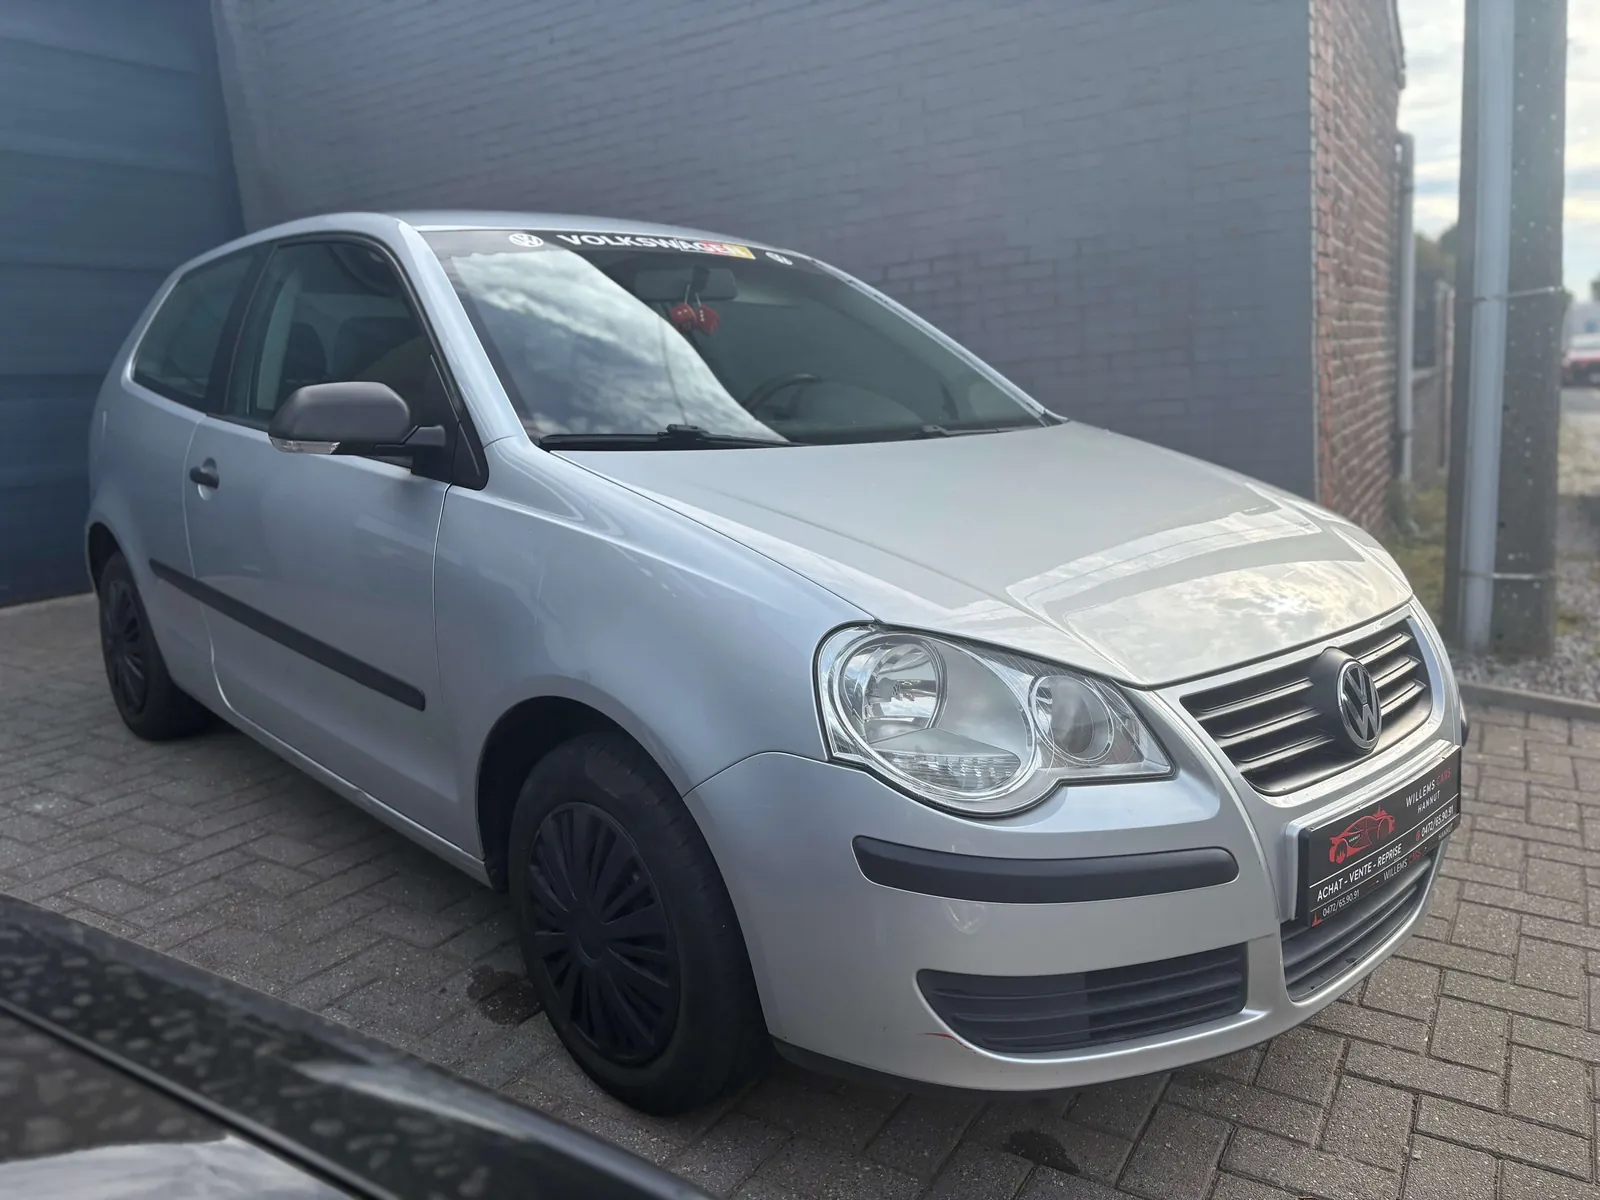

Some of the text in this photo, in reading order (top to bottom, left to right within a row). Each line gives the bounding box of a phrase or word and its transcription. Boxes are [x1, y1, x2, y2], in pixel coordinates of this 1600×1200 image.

[556, 234, 749, 259] VOLKSWAGEN
[1405, 767, 1451, 808] WILLEMS CARS
[1417, 789, 1440, 814] HANNUT
[1316, 877, 1343, 902] ACHAT
[1349, 861, 1372, 883] VENTE
[1377, 842, 1402, 867] REPRISE
[1322, 889, 1360, 917] 0472/65.90.91
[1383, 858, 1408, 881] WILLEMS
